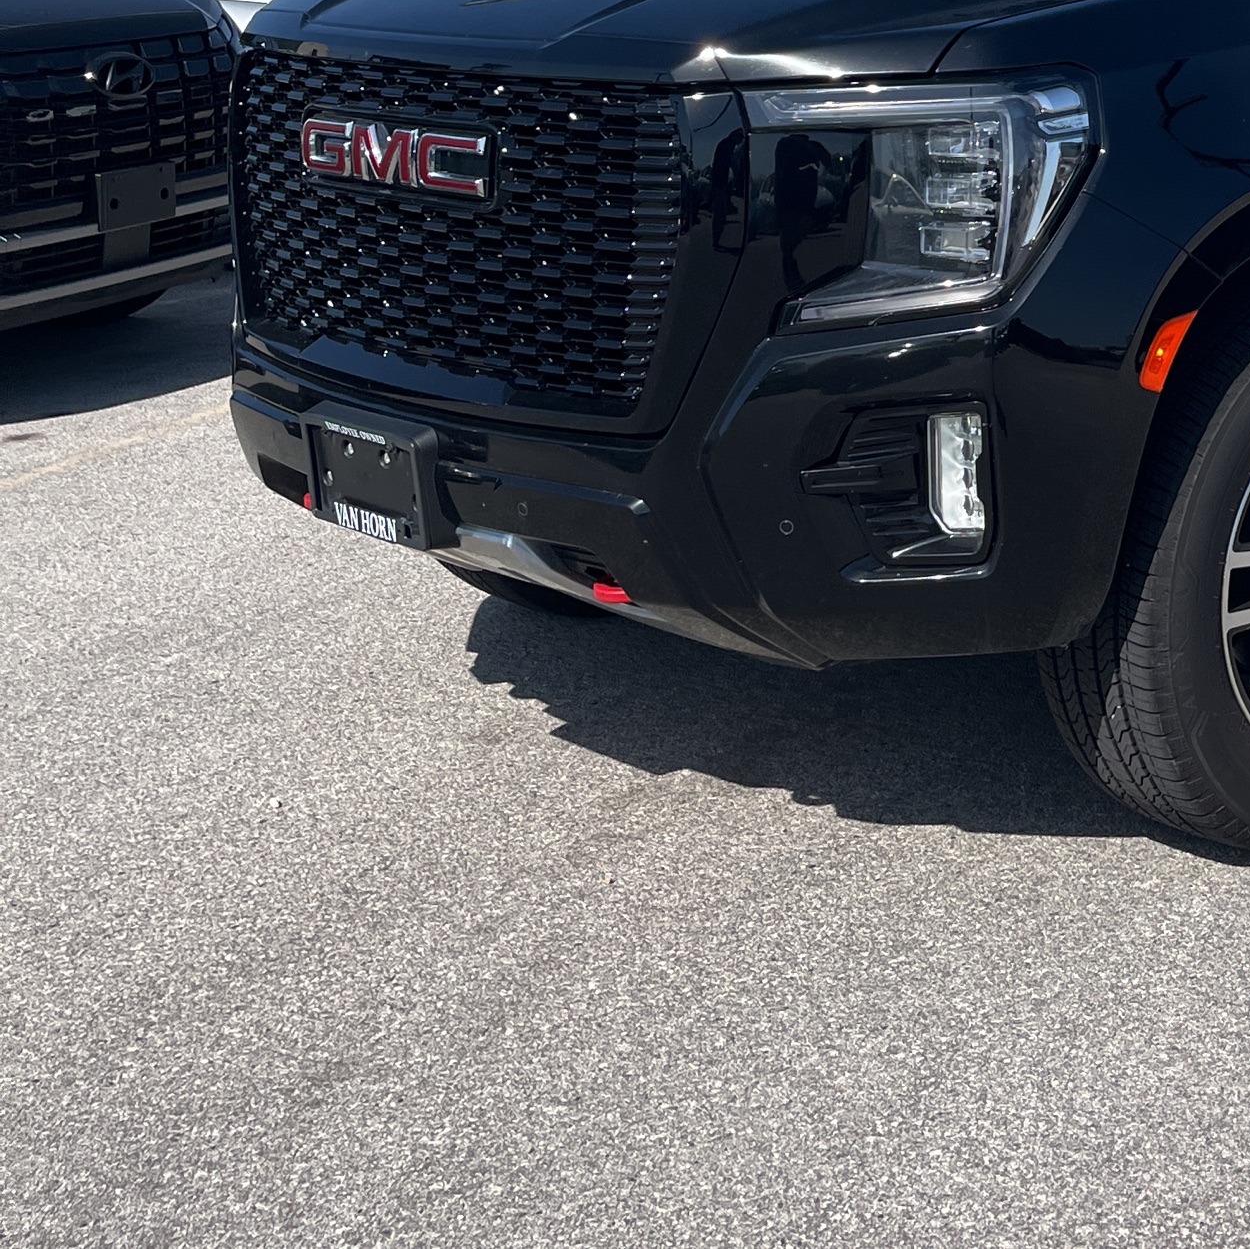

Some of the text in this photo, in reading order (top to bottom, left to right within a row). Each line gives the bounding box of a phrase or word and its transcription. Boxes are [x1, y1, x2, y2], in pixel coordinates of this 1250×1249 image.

[302, 118, 487, 198] GMC
[334, 501, 397, 542] VAN HORN
